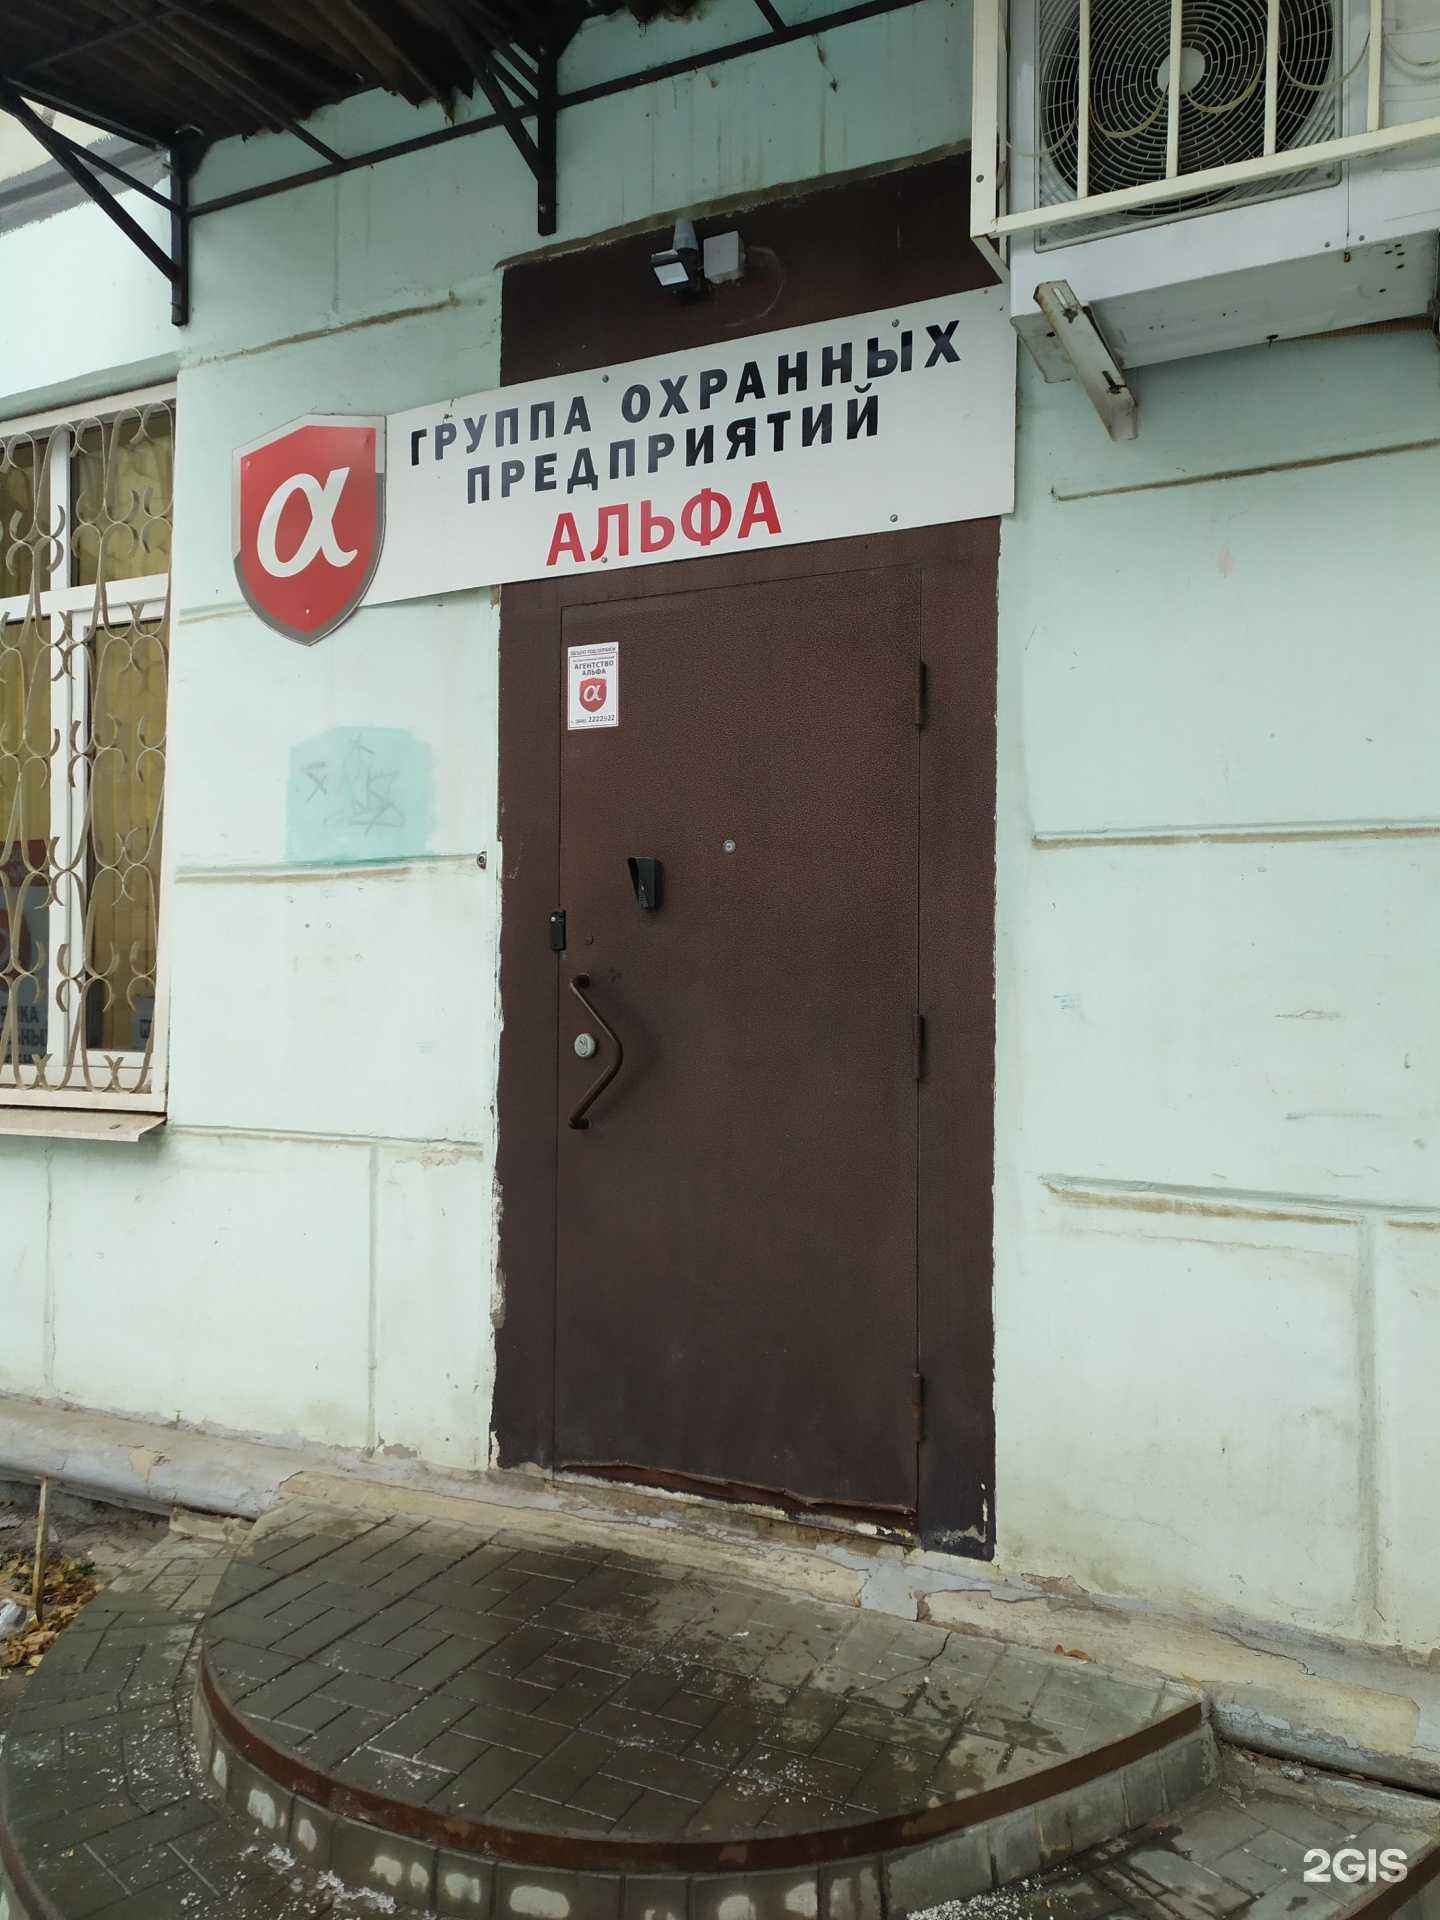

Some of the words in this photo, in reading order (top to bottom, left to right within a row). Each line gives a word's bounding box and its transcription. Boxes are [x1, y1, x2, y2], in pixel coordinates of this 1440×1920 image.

[411, 396, 591, 466] ГРУППА
[621, 320, 961, 423] ОХРАННЫХ
[467, 382, 879, 504] ПРЕДПРИЯТИЙ
[546, 481, 782, 566] АЛЬФА
[574, 660, 614, 670] АГЕНТСТВО
[582, 668, 607, 676] АЛЬФА
